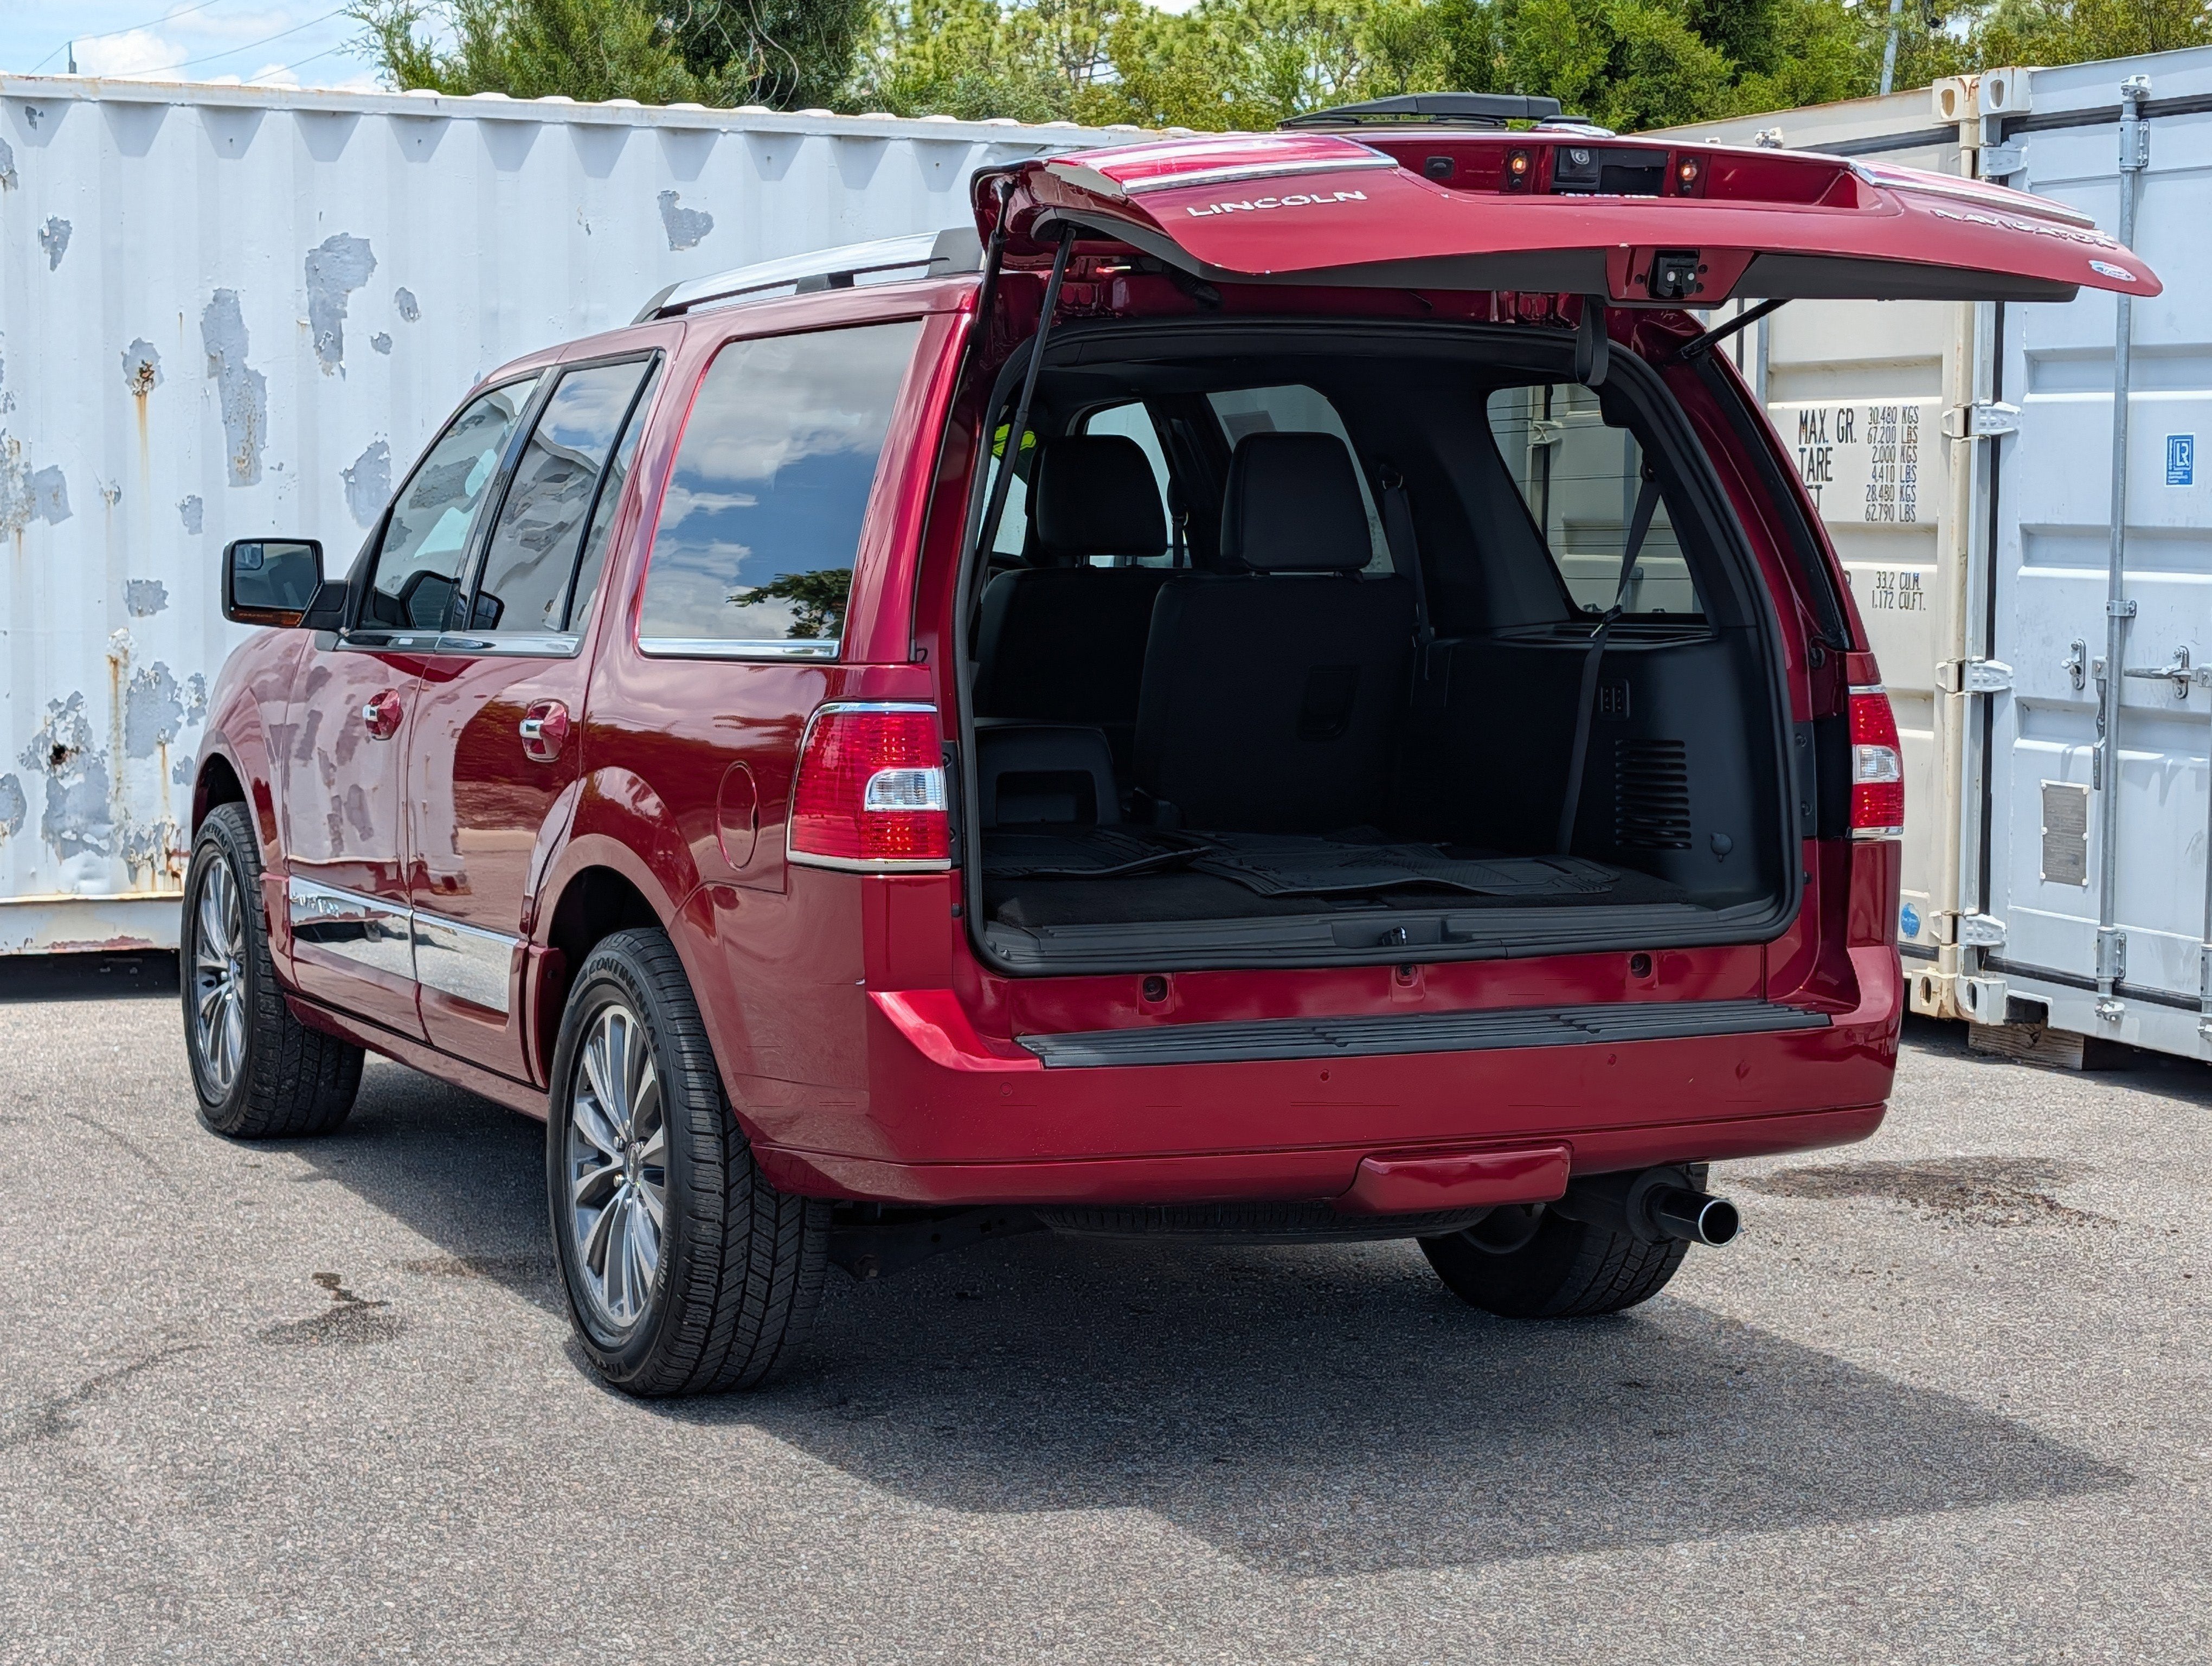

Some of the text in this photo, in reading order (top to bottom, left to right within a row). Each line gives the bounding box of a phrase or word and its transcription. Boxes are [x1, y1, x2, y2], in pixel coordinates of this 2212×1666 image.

[1186, 190, 1368, 217] LINCOLN
[1901, 405, 1919, 424] KGS
[1836, 408, 1857, 444] GR.
[1901, 425, 1918, 444] LBS
[1798, 446, 1833, 482] TARE
[1900, 445, 1918, 464] KGS
[1900, 464, 1918, 483] LBS
[1899, 484, 1917, 503] KGS
[1899, 503, 1916, 522] LBS
[587, 957, 661, 1054] CONTINENTAL
